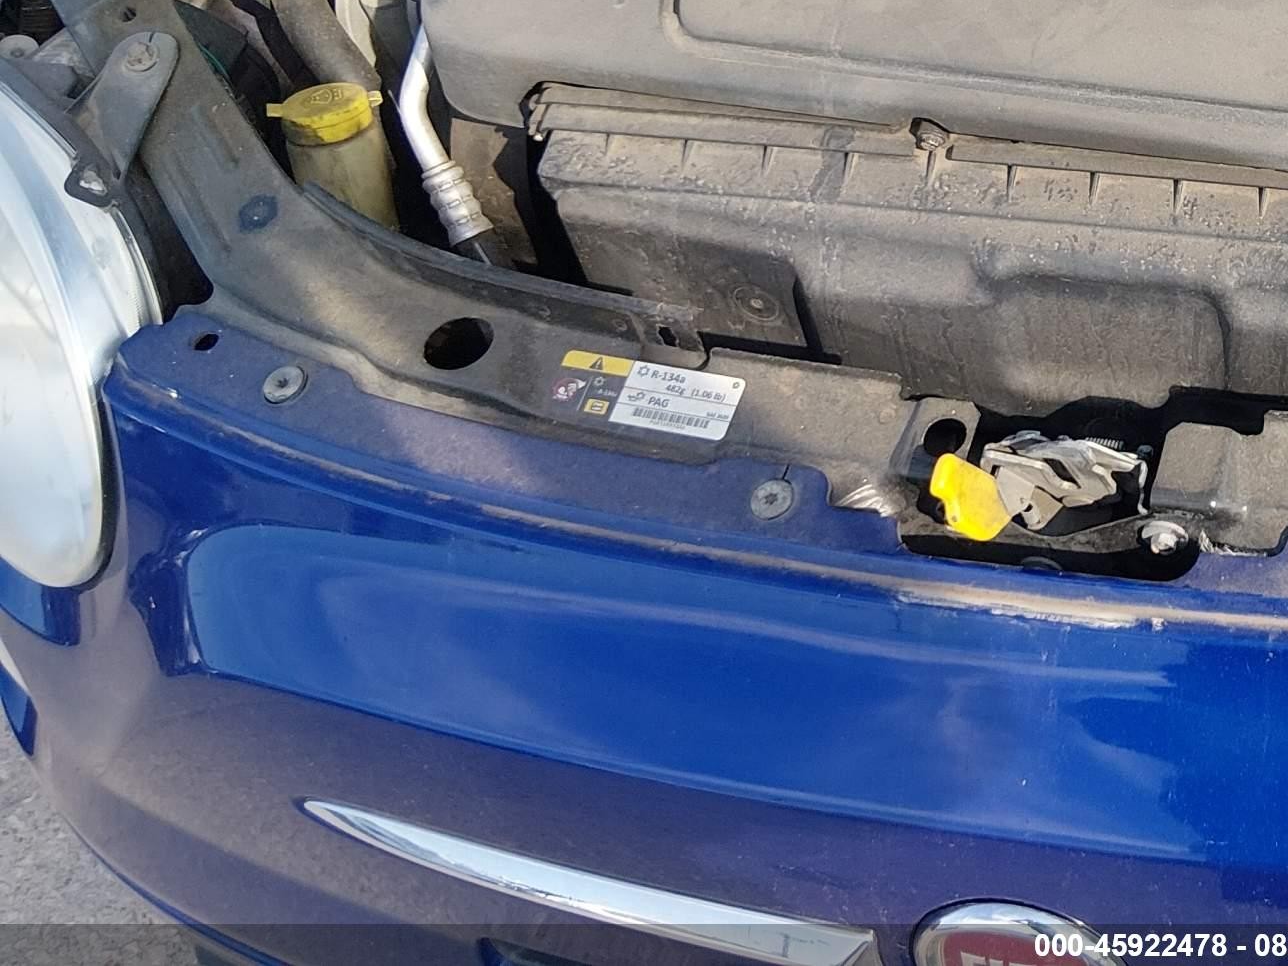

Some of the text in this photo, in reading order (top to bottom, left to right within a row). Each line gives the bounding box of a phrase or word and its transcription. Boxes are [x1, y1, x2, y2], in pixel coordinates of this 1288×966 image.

[651, 369, 686, 384] R-134a
[666, 384, 686, 395] 482g
[647, 396, 670, 408] PAG
